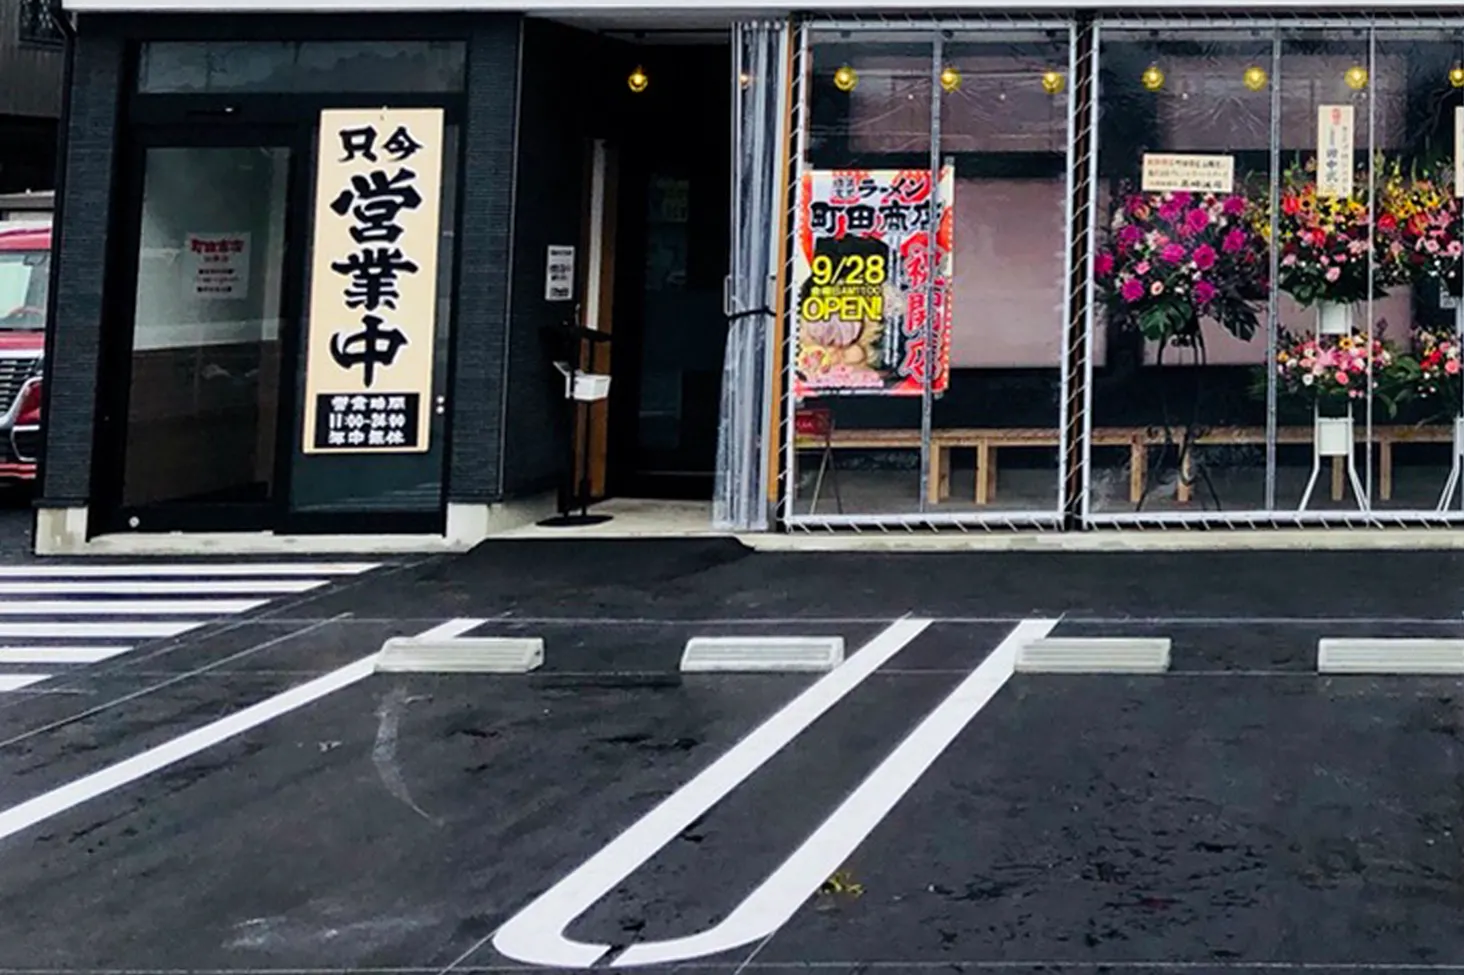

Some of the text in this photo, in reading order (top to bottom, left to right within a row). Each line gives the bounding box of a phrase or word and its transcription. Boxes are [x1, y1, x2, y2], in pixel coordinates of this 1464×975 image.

[338, 126, 424, 162] 只今
[810, 200, 943, 234] 町田商店
[330, 167, 423, 388] 営業中
[812, 254, 885, 285] 9/28
[801, 295, 883, 322] OPEN!
